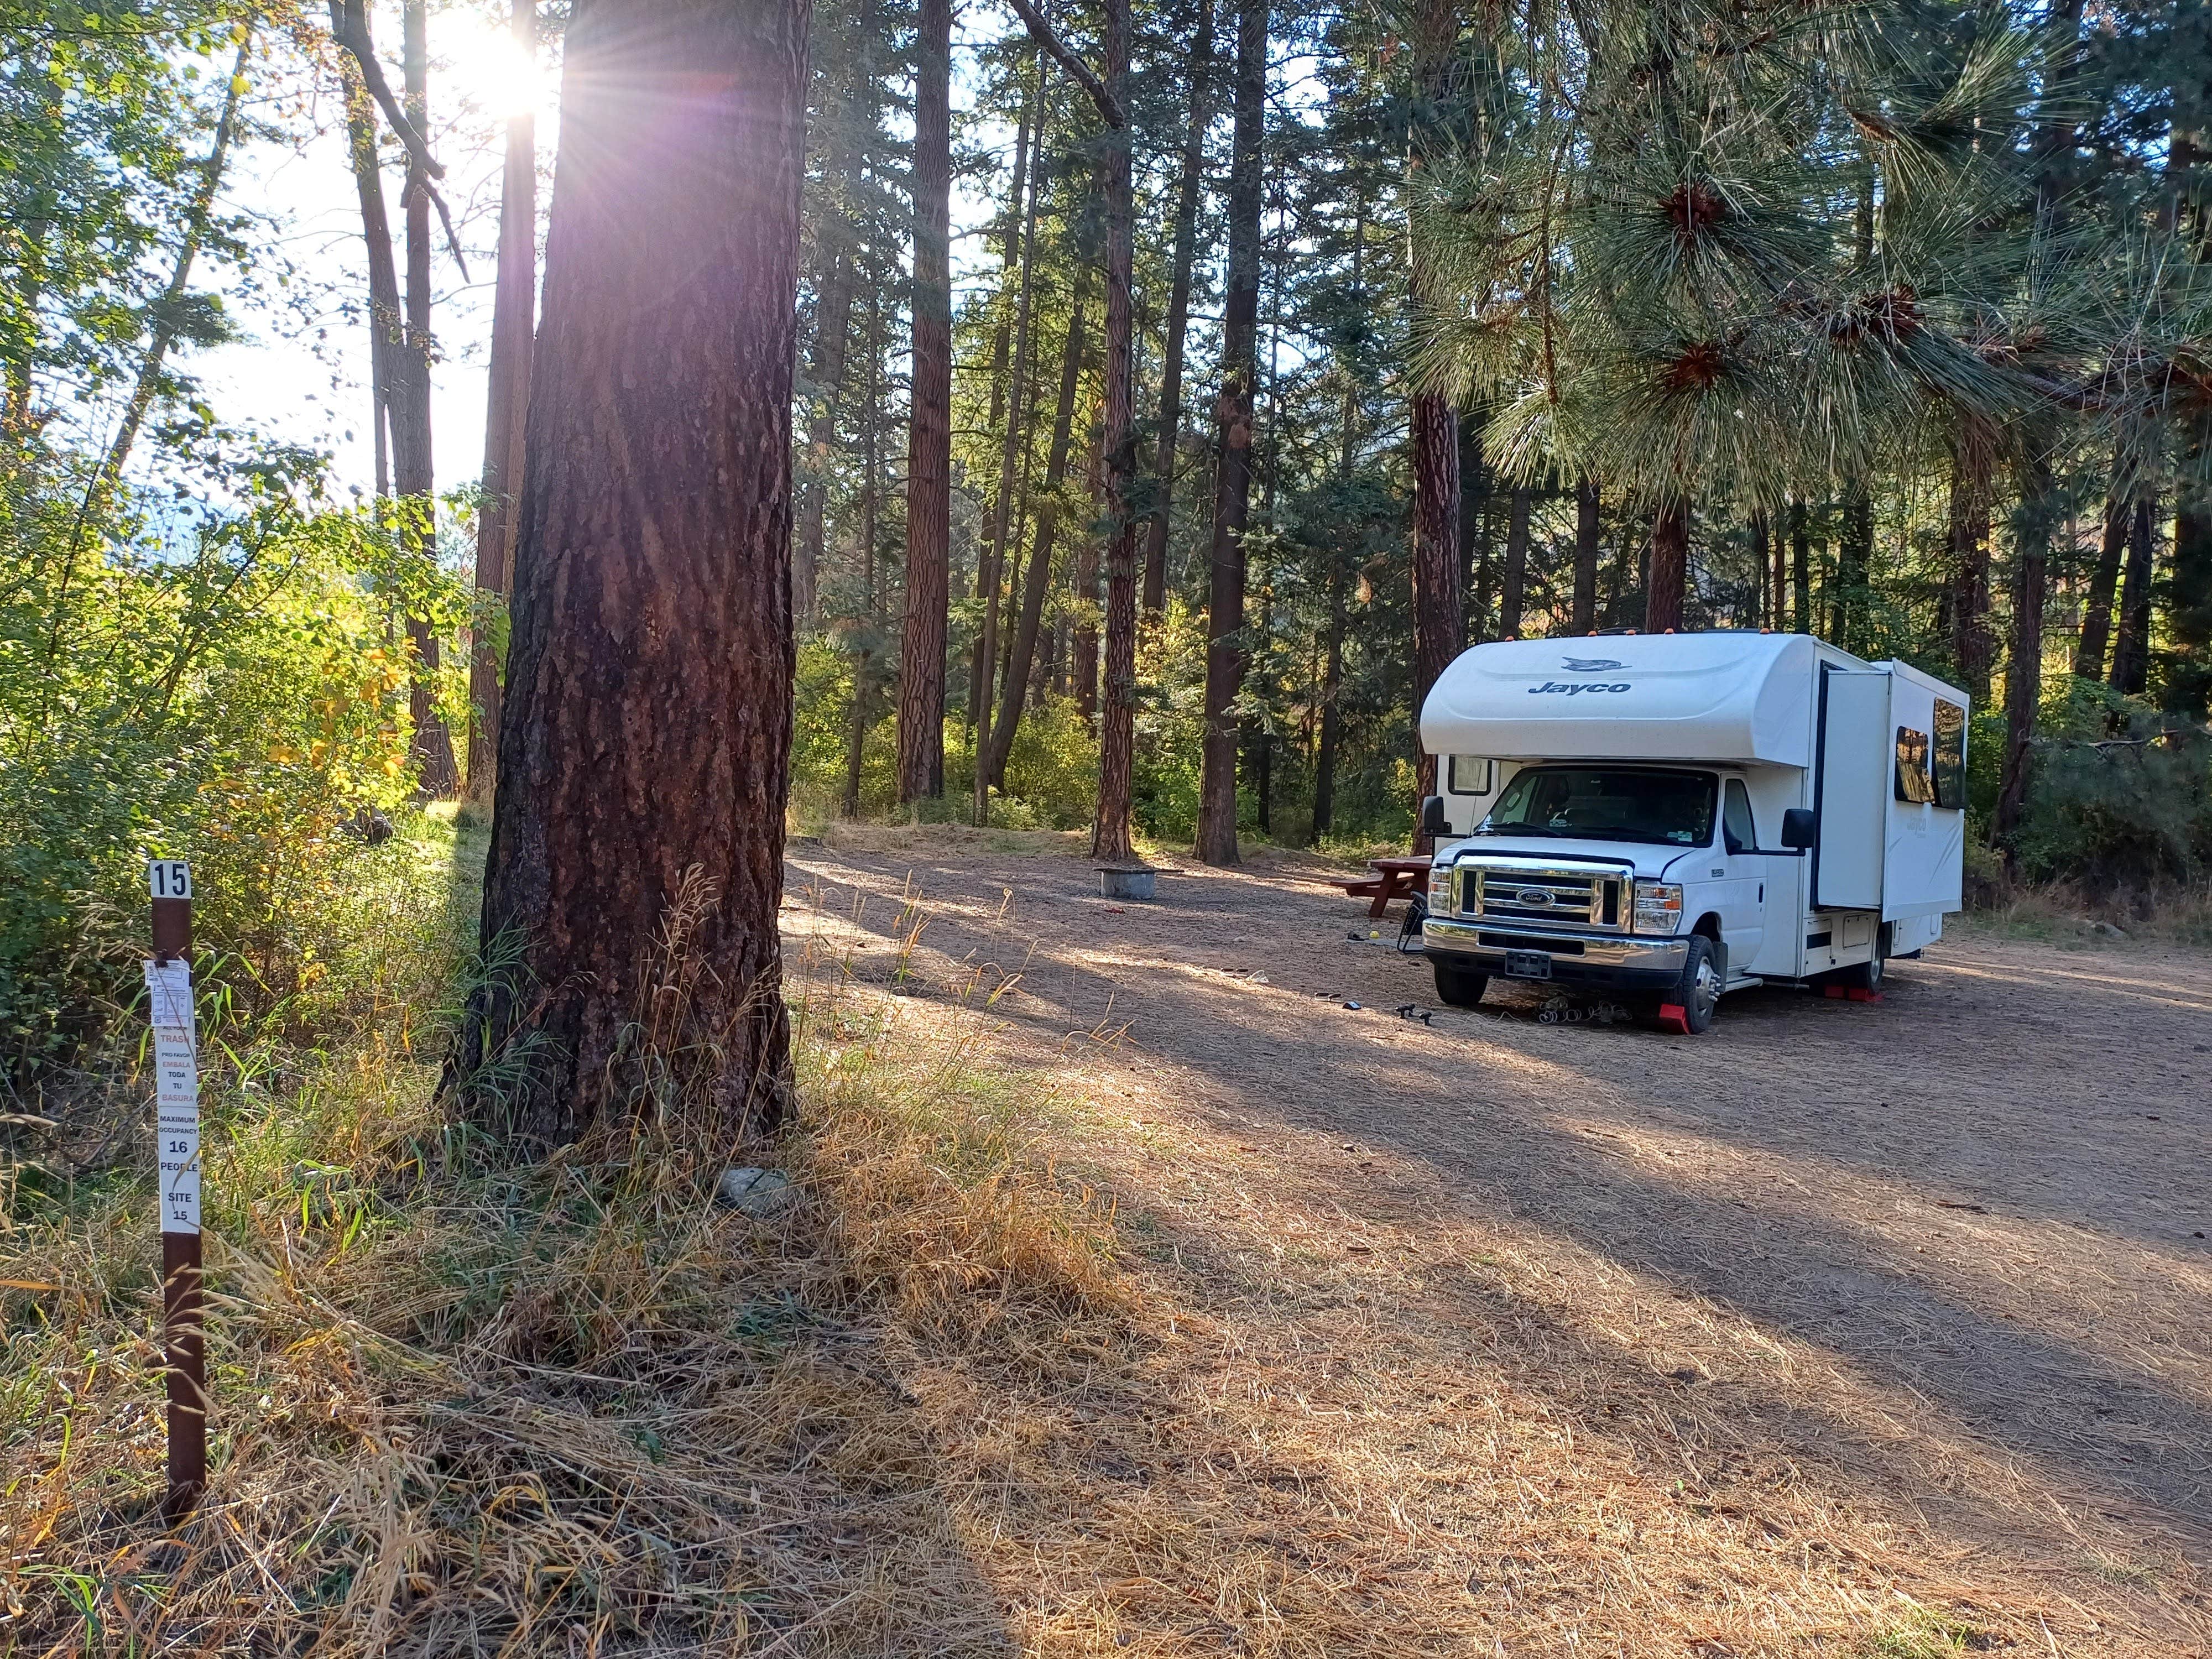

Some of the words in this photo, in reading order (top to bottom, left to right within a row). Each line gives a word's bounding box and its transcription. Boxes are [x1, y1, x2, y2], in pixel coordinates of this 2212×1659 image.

[1528, 682, 1631, 696] Jayco
[155, 864, 186, 895] 15
[1525, 893, 1542, 901] Ford
[170, 1141, 187, 1153] 16
[168, 1192, 192, 1202] SITE
[174, 1211, 187, 1220] 15
